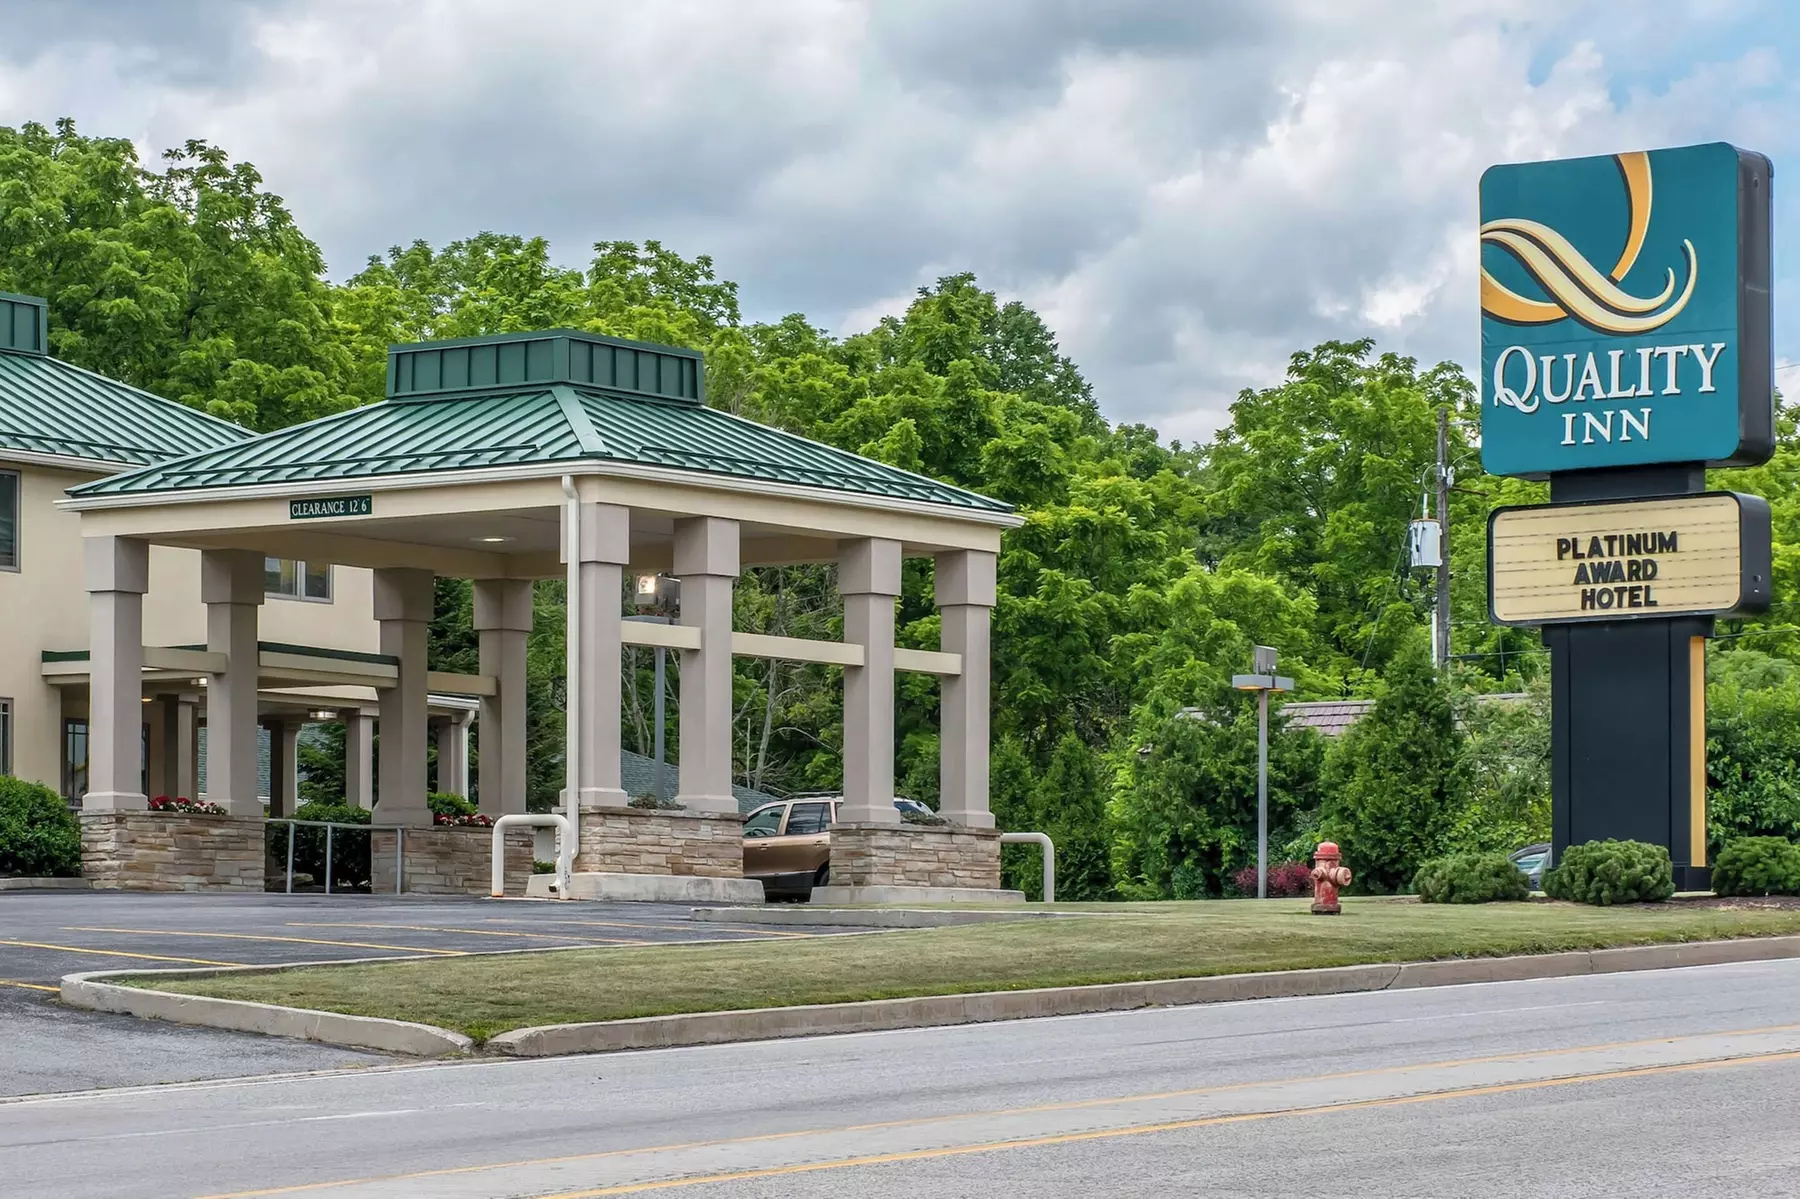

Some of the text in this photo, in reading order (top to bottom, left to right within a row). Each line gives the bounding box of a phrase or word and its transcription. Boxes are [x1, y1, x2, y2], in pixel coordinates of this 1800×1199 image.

[1493, 342, 1726, 413] QUALITY
[1561, 408, 1651, 446] INN
[291, 501, 346, 516] CLEARANCE
[1556, 531, 1678, 561] PLATINUM
[1573, 558, 1659, 585] AWARD
[1580, 585, 1658, 611] HOTEL
